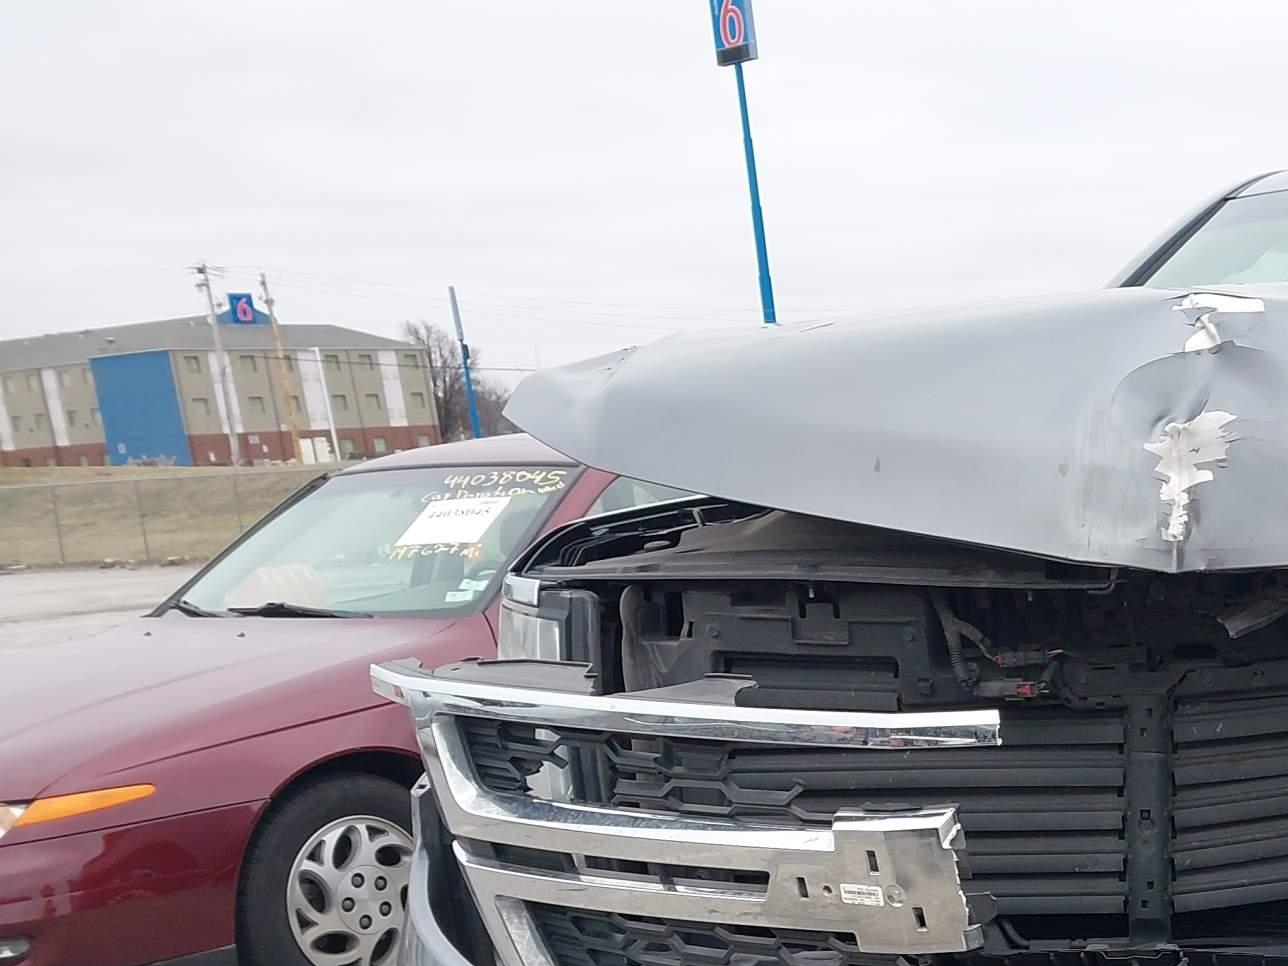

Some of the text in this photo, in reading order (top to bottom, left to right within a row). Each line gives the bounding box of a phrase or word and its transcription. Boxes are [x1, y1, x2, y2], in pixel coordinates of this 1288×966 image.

[720, 0, 744, 47] 6
[237, 297, 253, 321] 6
[443, 471, 567, 489] 44038045
